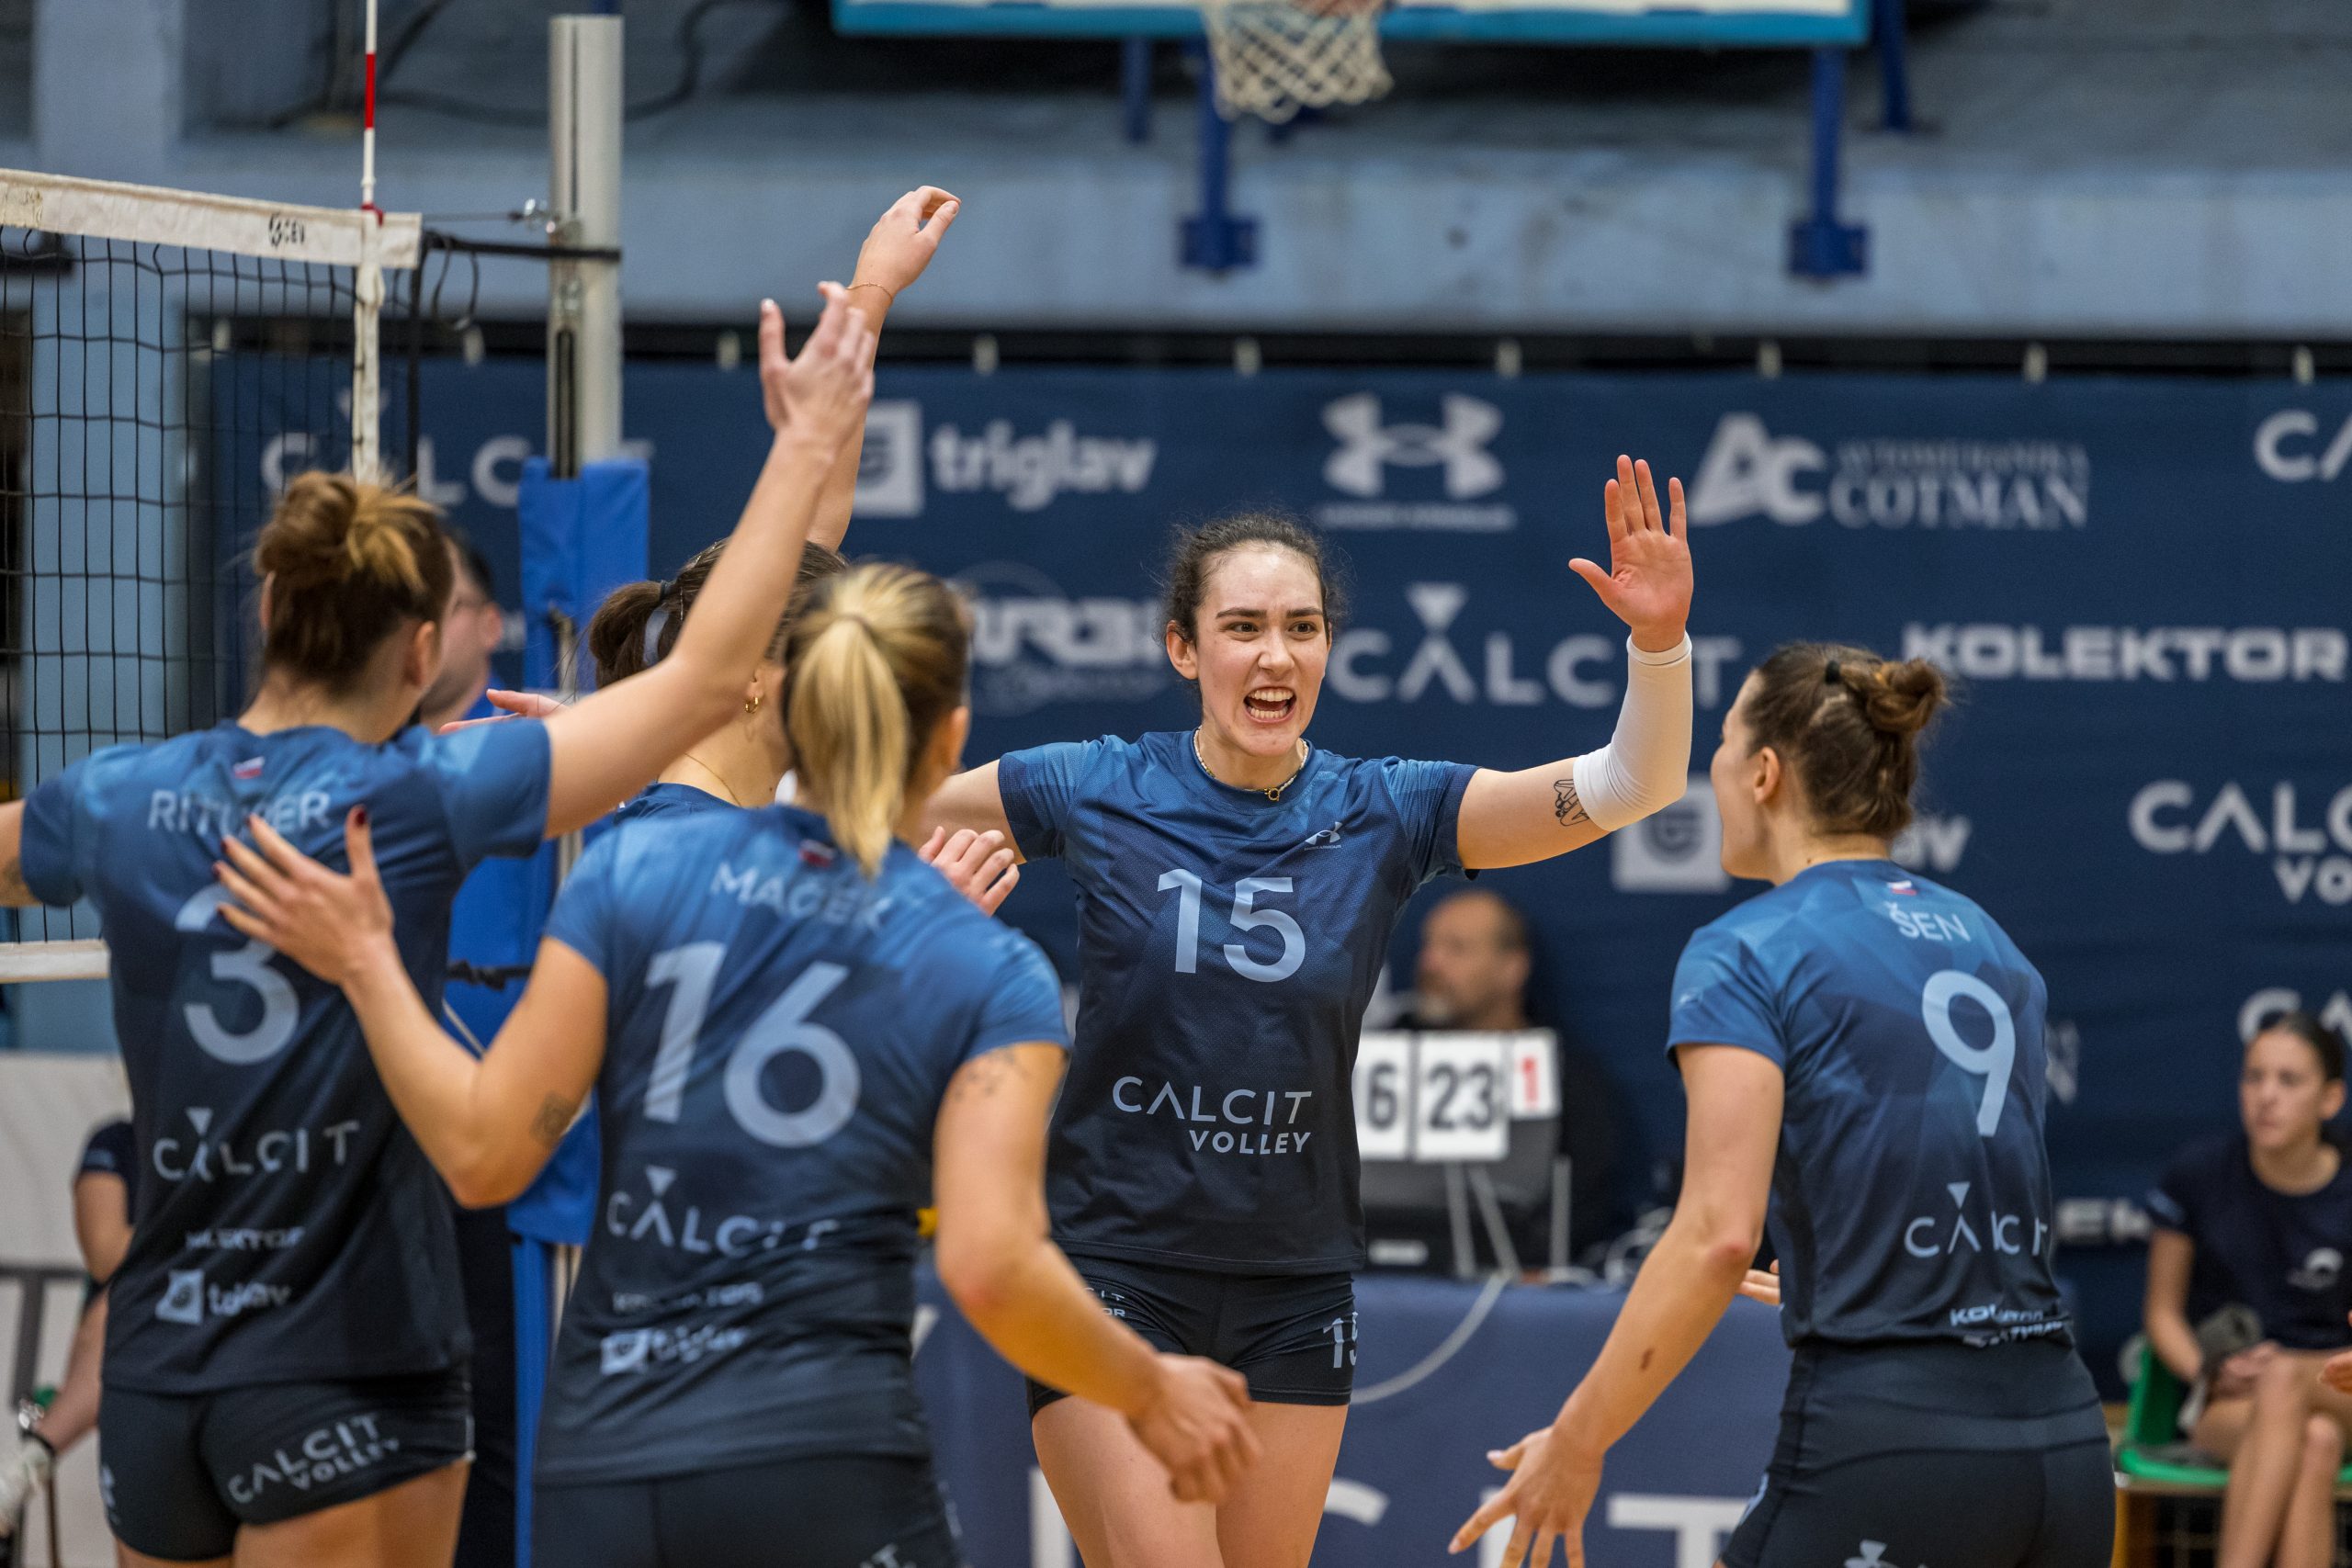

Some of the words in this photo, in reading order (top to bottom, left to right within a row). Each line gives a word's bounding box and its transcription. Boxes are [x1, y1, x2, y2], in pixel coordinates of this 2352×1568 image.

[931, 418, 1159, 512] triglav
[1827, 474, 2086, 530] COTMAN
[1326, 627, 1743, 708] CALCT
[1902, 623, 2350, 682] KOLEKTOR
[1157, 868, 1306, 982] 15
[1884, 900, 1971, 942] ŠEN
[175, 883, 300, 1065] 3
[645, 940, 861, 1148] 16
[1922, 970, 2016, 1137] 9
[1112, 1076, 1312, 1127] CALCIT
[1427, 1061, 1495, 1133] 23
[1521, 1056, 1540, 1112] 1
[1188, 1130, 1312, 1156] VOLLEY
[229, 1413, 379, 1504] CALCIT
